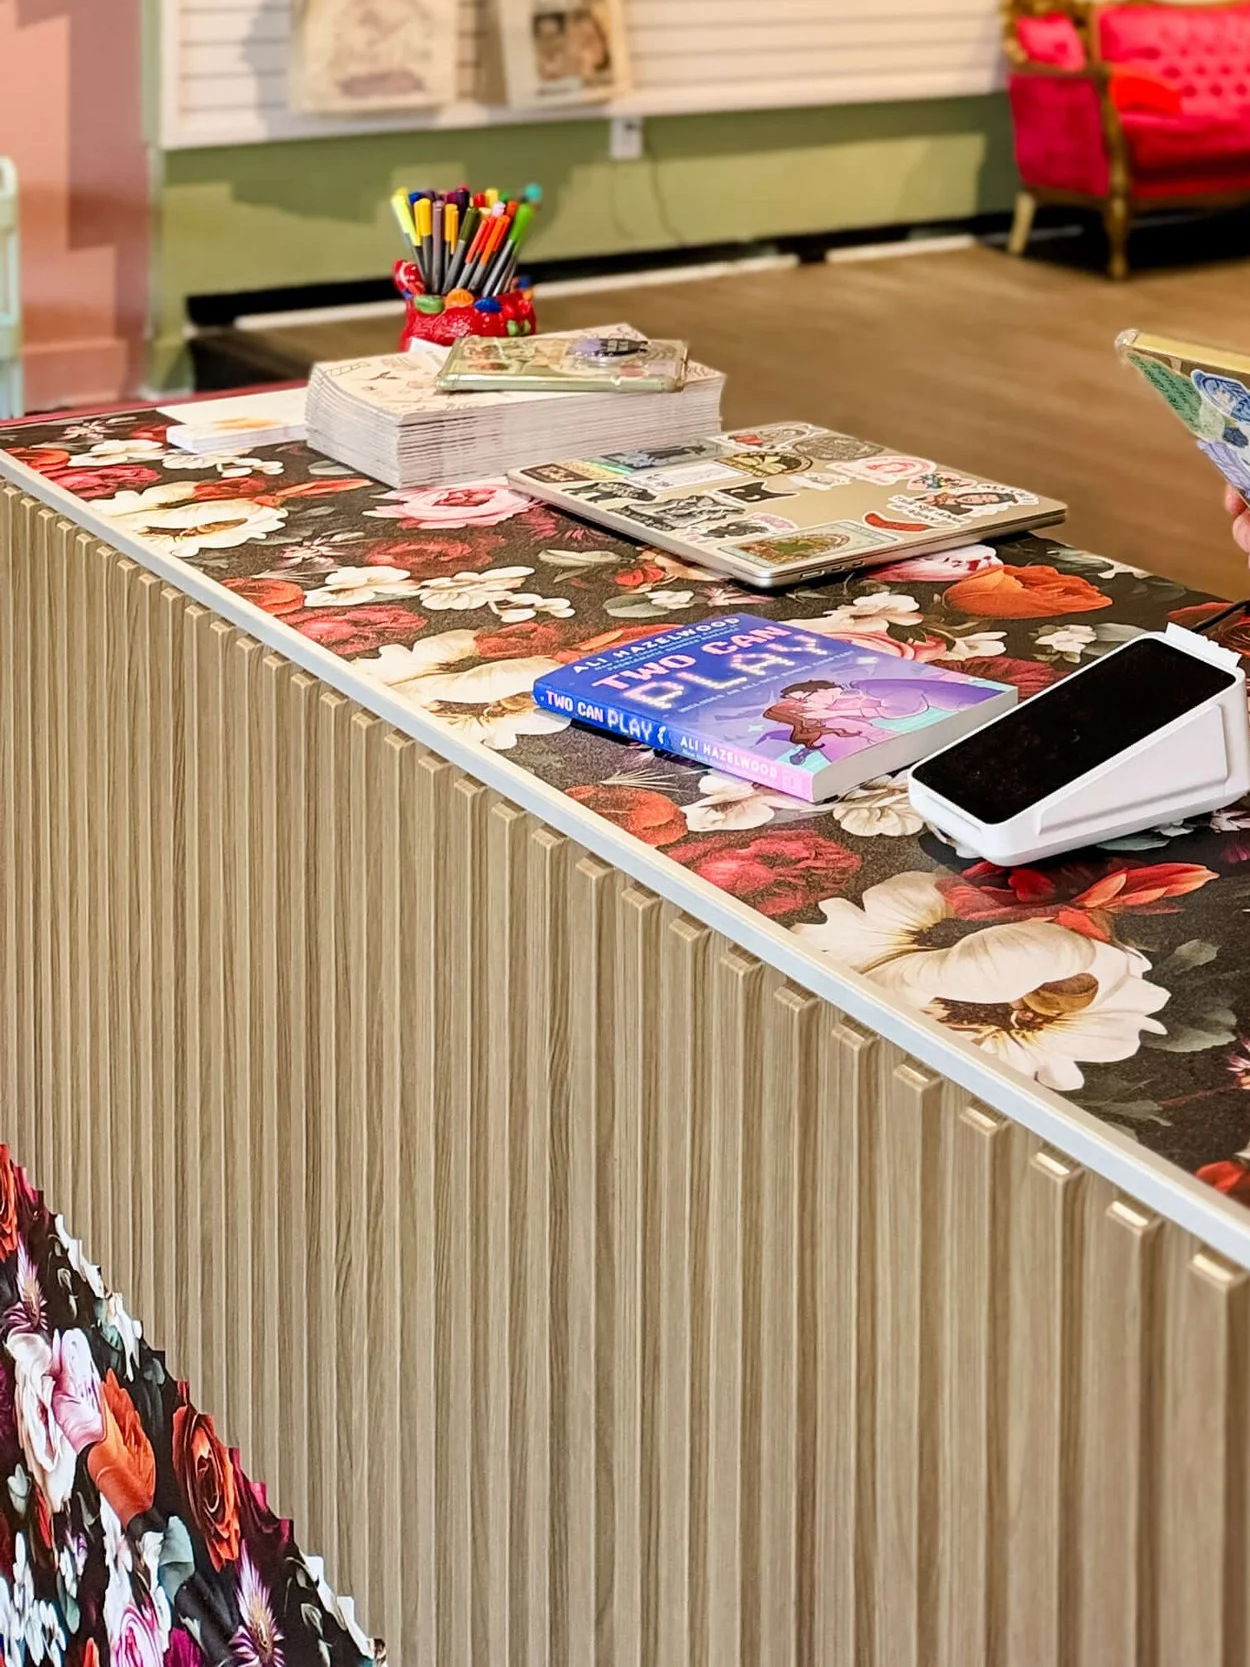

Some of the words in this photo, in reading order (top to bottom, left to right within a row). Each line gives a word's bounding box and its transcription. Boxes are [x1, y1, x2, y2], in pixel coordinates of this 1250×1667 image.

[573, 657, 606, 674] ALI
[612, 617, 740, 659] HAZELWOOD
[592, 654, 697, 690] TWO
[701, 626, 792, 655] CAN
[622, 634, 829, 710] PLAY
[546, 690, 573, 713] TWO
[577, 701, 604, 723] CAN
[607, 710, 653, 741] PLAY
[680, 736, 699, 751] ALI
[703, 743, 778, 778] HAZELWOOD
